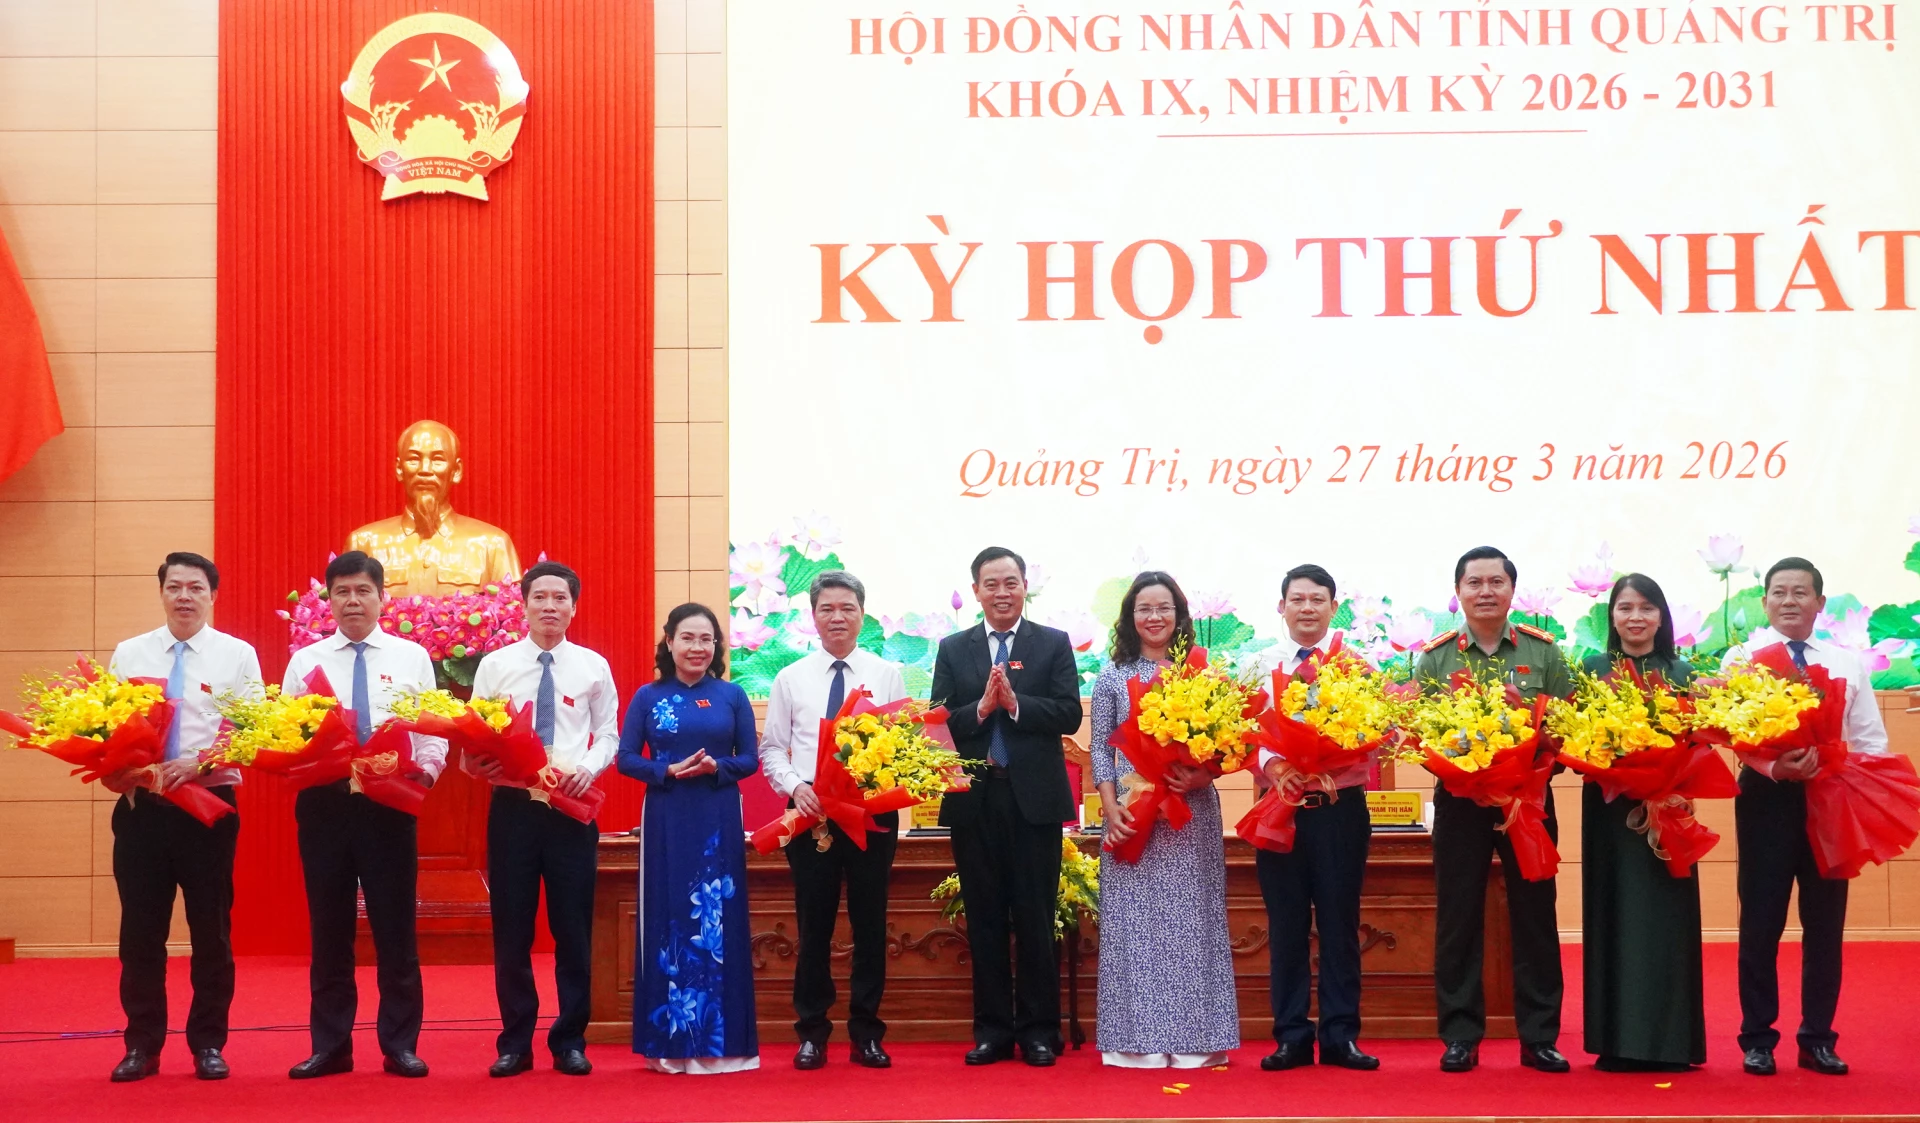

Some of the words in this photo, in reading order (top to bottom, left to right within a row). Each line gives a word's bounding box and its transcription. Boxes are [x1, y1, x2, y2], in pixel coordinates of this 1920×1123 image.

[849, 10, 947, 65] HỘI
[963, 4, 1123, 54] ĐỒNG
[1139, 0, 1292, 51] NHÂN
[1311, 0, 1423, 49] DÂN
[1438, 0, 1574, 47] TỈNH
[1804, 3, 1898, 52] TRỊ
[964, 68, 1125, 118] KHÓA
[1141, 79, 1210, 124] IX,
[1228, 70, 1409, 124] NHIỆM
[1430, 63, 1504, 113] KỲ
[1522, 72, 1628, 111] 2026
[1676, 70, 1777, 109] 2031
[408, 166, 434, 177] VIỆT
[436, 167, 462, 178] NAM
[810, 214, 983, 324] KỲ
[1016, 238, 1269, 345] HỌP
[1295, 208, 1563, 318] THỨ
[1590, 203, 1920, 315] NHẤT
[959, 448, 1104, 498] Quảng
[1122, 447, 1189, 493] Trị,
[1208, 445, 1313, 495] ngày
[1327, 444, 1382, 483] 27
[1394, 443, 1518, 493] tháng
[1531, 442, 1556, 482] 3
[1572, 443, 1664, 481] năm
[1679, 440, 1790, 480] 2026
